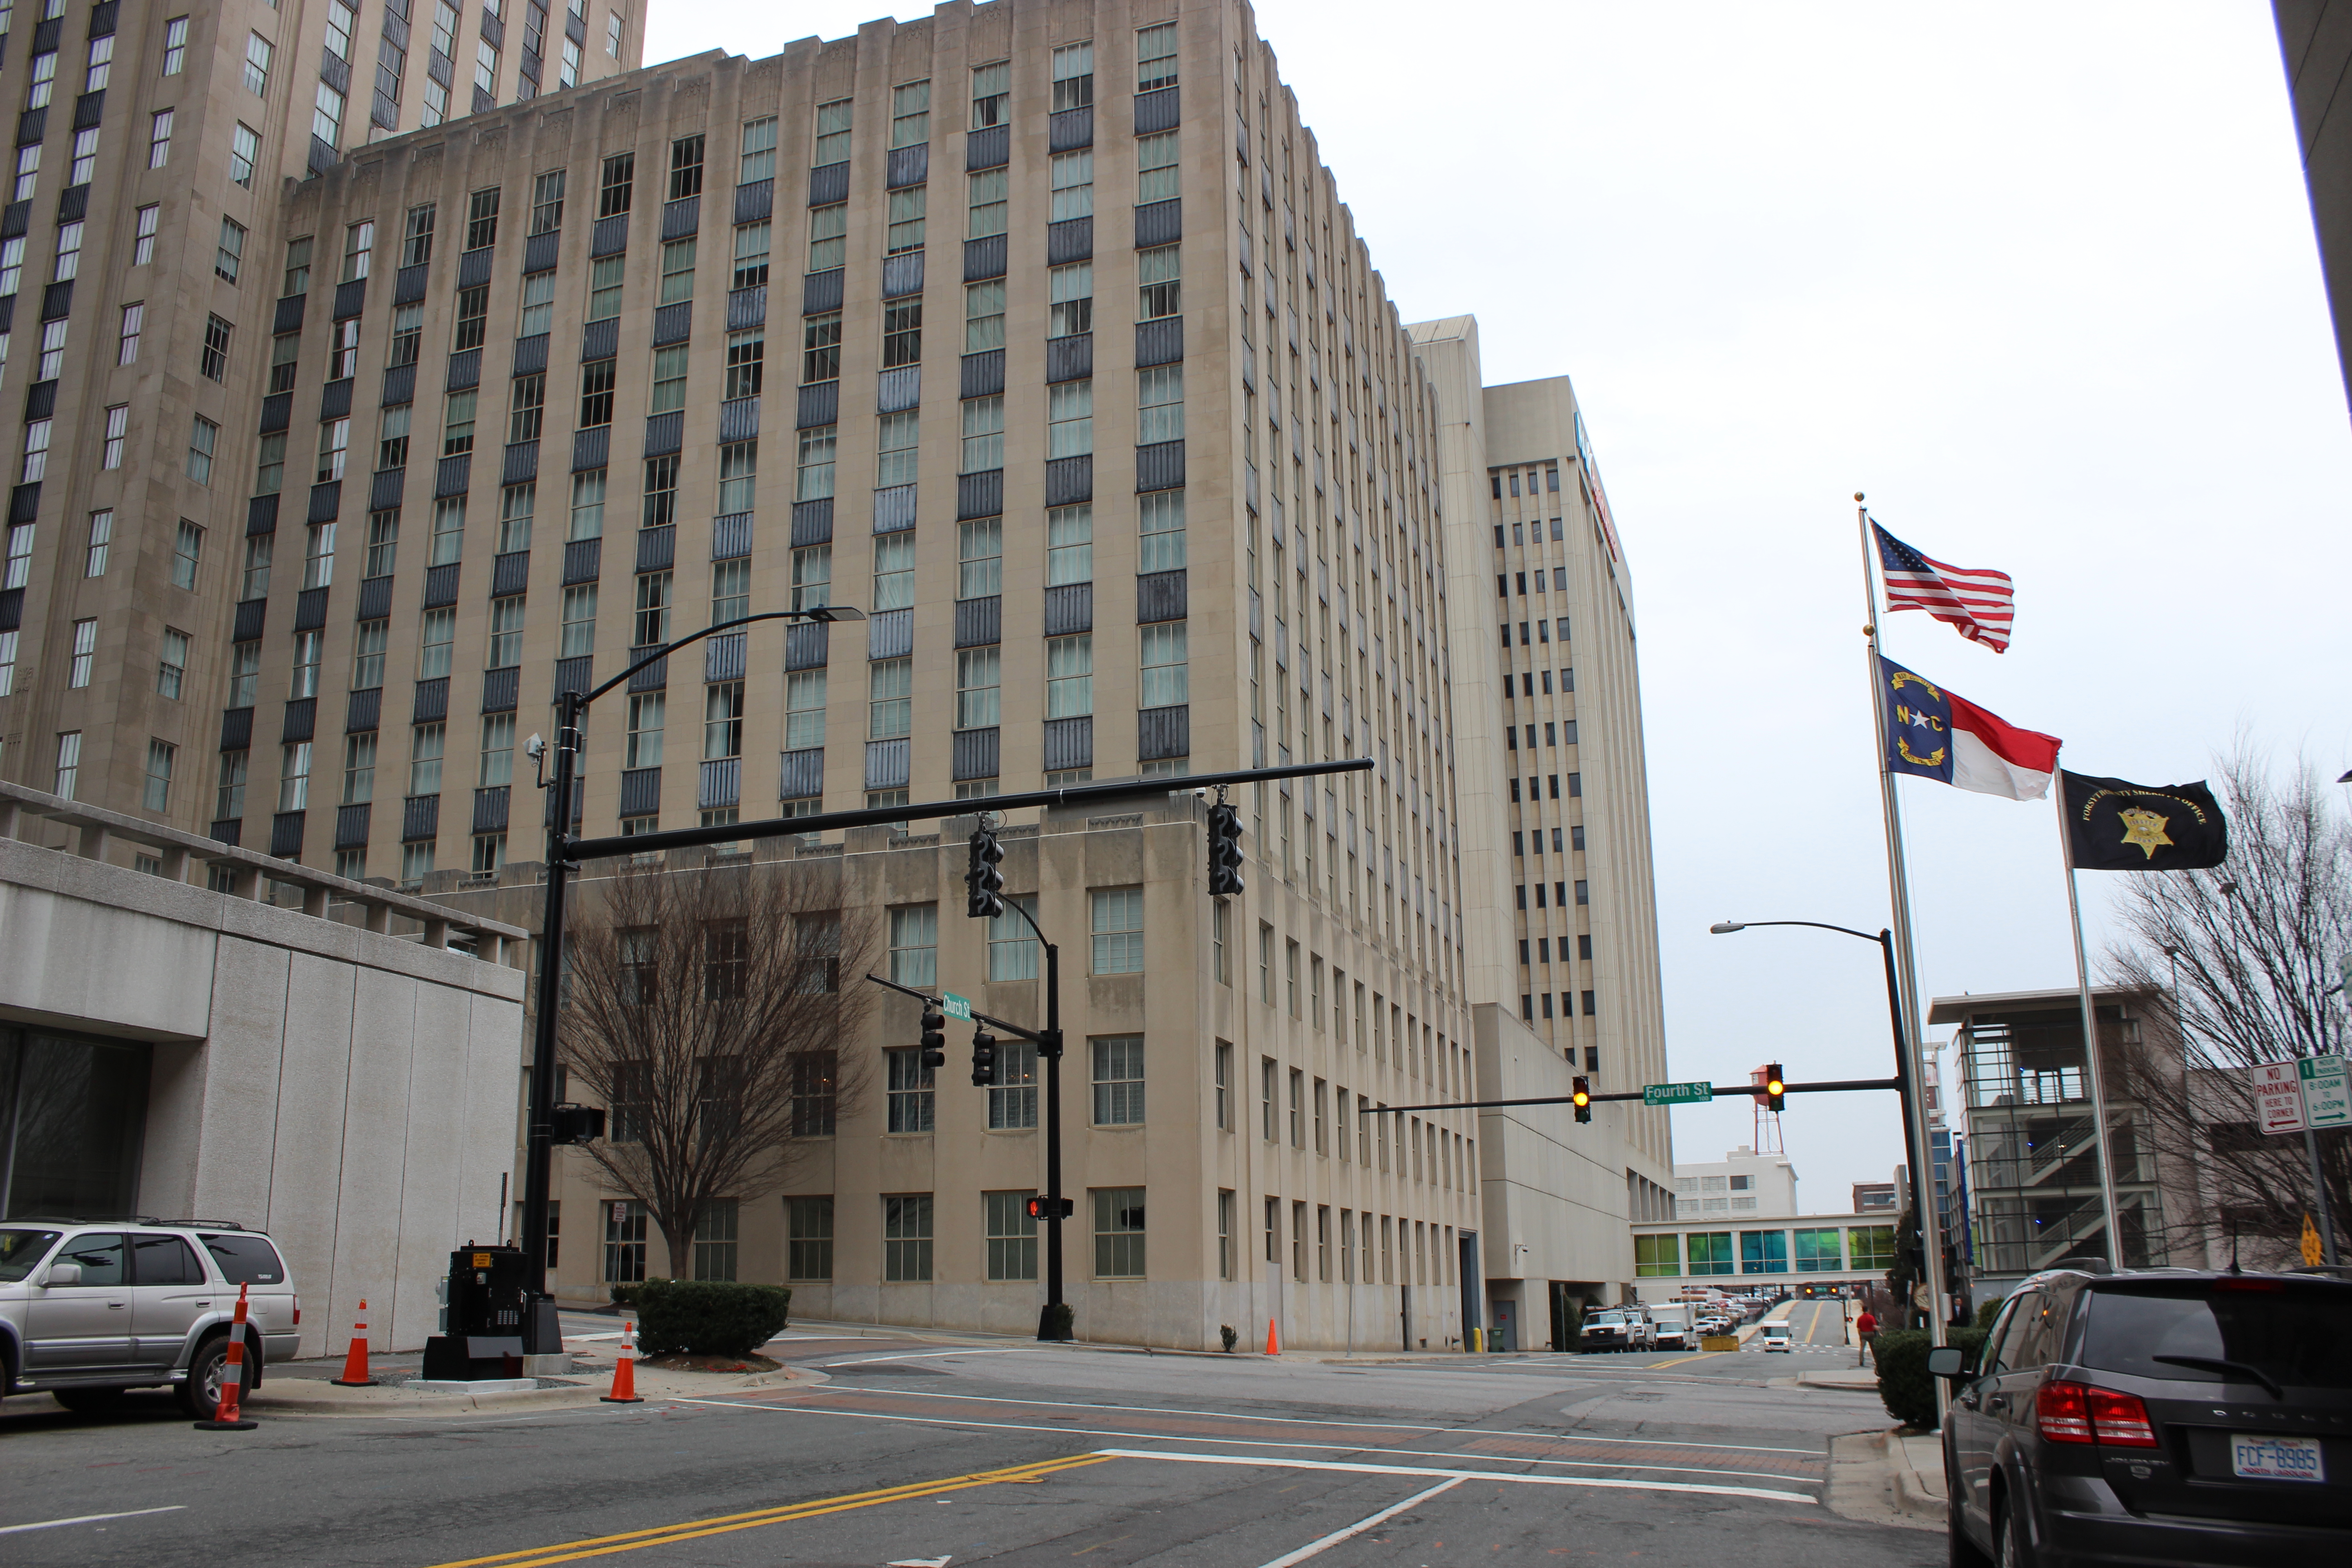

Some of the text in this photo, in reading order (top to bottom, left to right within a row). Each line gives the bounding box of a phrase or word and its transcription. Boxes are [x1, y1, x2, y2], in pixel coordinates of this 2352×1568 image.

[1896, 705, 1943, 732] N C
[2181, 799, 2207, 825] OFFICE
[944, 995, 970, 1019] Church St
[2318, 1058, 2336, 1066] HOUR
[2266, 1067, 2280, 1081] NO
[2303, 1063, 2310, 1076] 1
[2315, 1065, 2342, 1074] PARKING
[1646, 1083, 1709, 1098] Fourth St
[2256, 1080, 2297, 1097] PARKING
[2264, 1096, 2293, 1108] HERE TO
[2267, 1107, 2294, 1119] CORNER
[2237, 1445, 2318, 1470] FCF-8985
